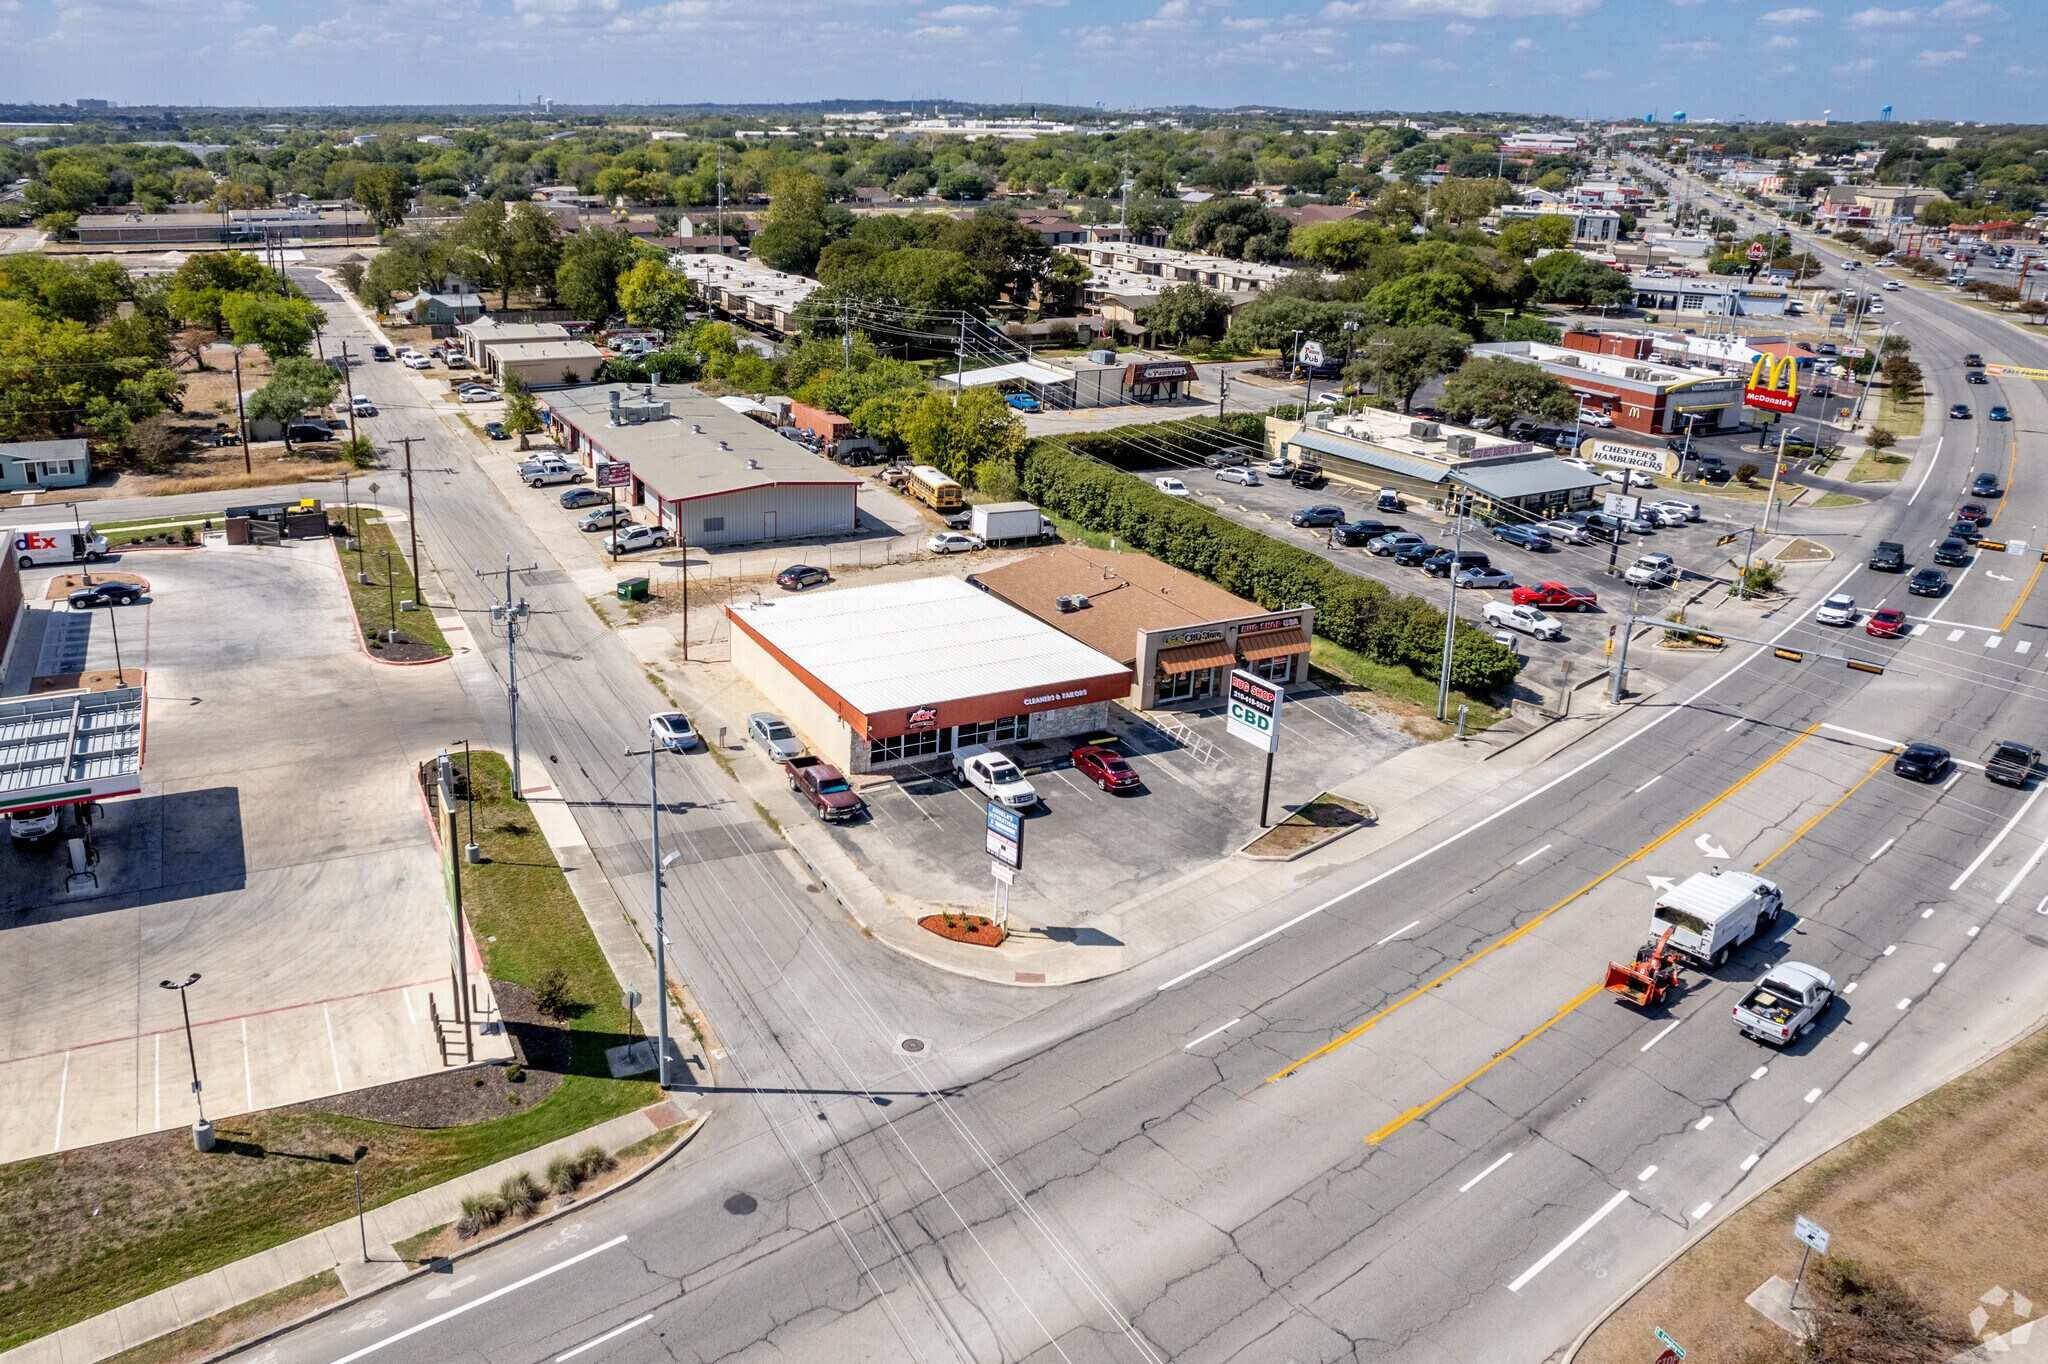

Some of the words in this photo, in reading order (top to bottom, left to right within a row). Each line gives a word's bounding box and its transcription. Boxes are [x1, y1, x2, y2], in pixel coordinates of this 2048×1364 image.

[1745, 249, 1767, 257] Arby's
[1304, 353, 1319, 363] Pub
[1746, 392, 1793, 408] McDonald's
[1493, 446, 1510, 456] BURGERS
[1602, 444, 1657, 462] CHESTER'S
[1594, 452, 1663, 472] HAMBURGERS
[15, 532, 58, 551] dEx
[1241, 623, 1259, 633] RUG
[1260, 620, 1282, 630] SHOP
[1282, 617, 1299, 627] USA
[1184, 631, 1202, 643] CBD
[1202, 630, 1222, 640] Store
[1023, 694, 1055, 706] CLEANERS
[1061, 689, 1088, 700] TAILORS
[1231, 676, 1250, 692] RUG
[1250, 685, 1275, 702] SHOP
[1231, 703, 1270, 731] CBD
[988, 812, 1018, 830] ALTERATIONS
